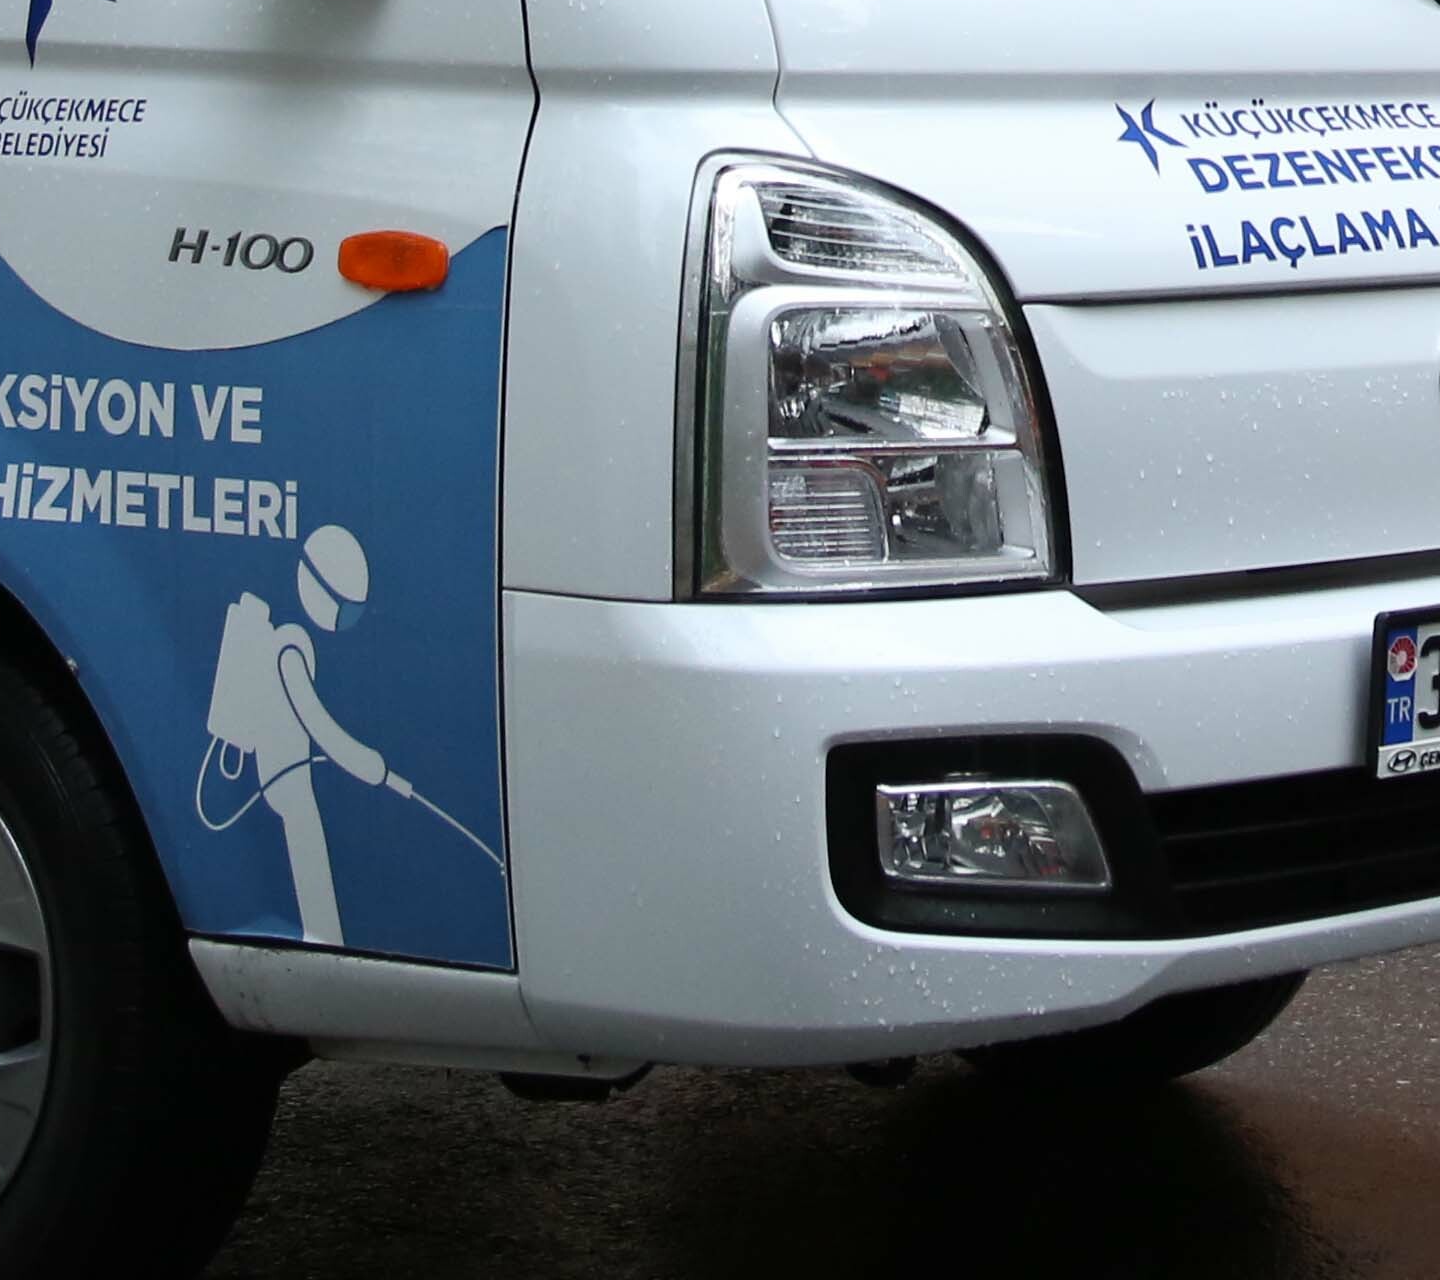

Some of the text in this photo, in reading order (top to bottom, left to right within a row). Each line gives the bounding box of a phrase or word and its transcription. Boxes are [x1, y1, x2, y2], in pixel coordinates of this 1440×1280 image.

[168, 226, 315, 274] H-100
[1186, 209, 1439, 269] İLAÇLAMA
[191, 384, 264, 444] VE
[1387, 695, 1412, 725] TR
